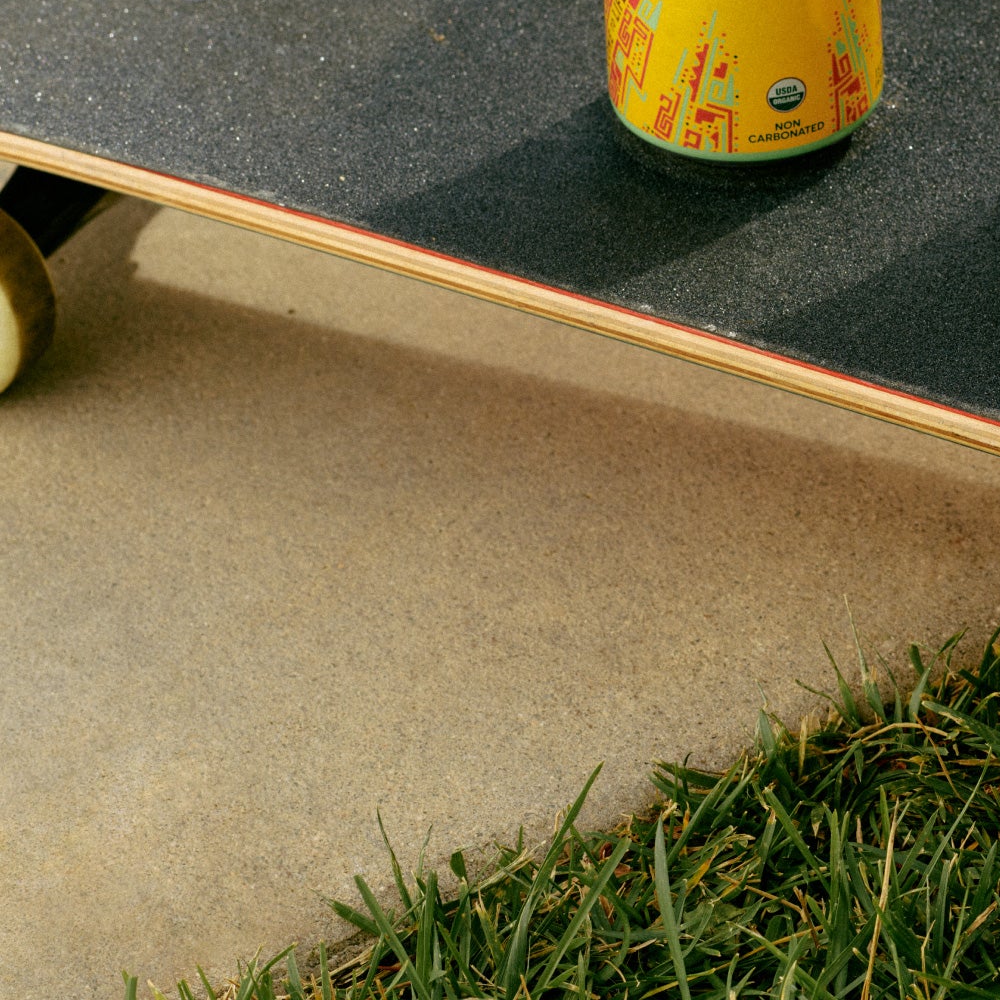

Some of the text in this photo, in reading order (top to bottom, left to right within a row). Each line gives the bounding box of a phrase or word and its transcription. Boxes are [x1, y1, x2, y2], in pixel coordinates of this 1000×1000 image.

[775, 85, 798, 96] USDA
[773, 94, 801, 105] ORGANIC
[775, 119, 801, 131] NON
[748, 121, 825, 144] CARBONATED
